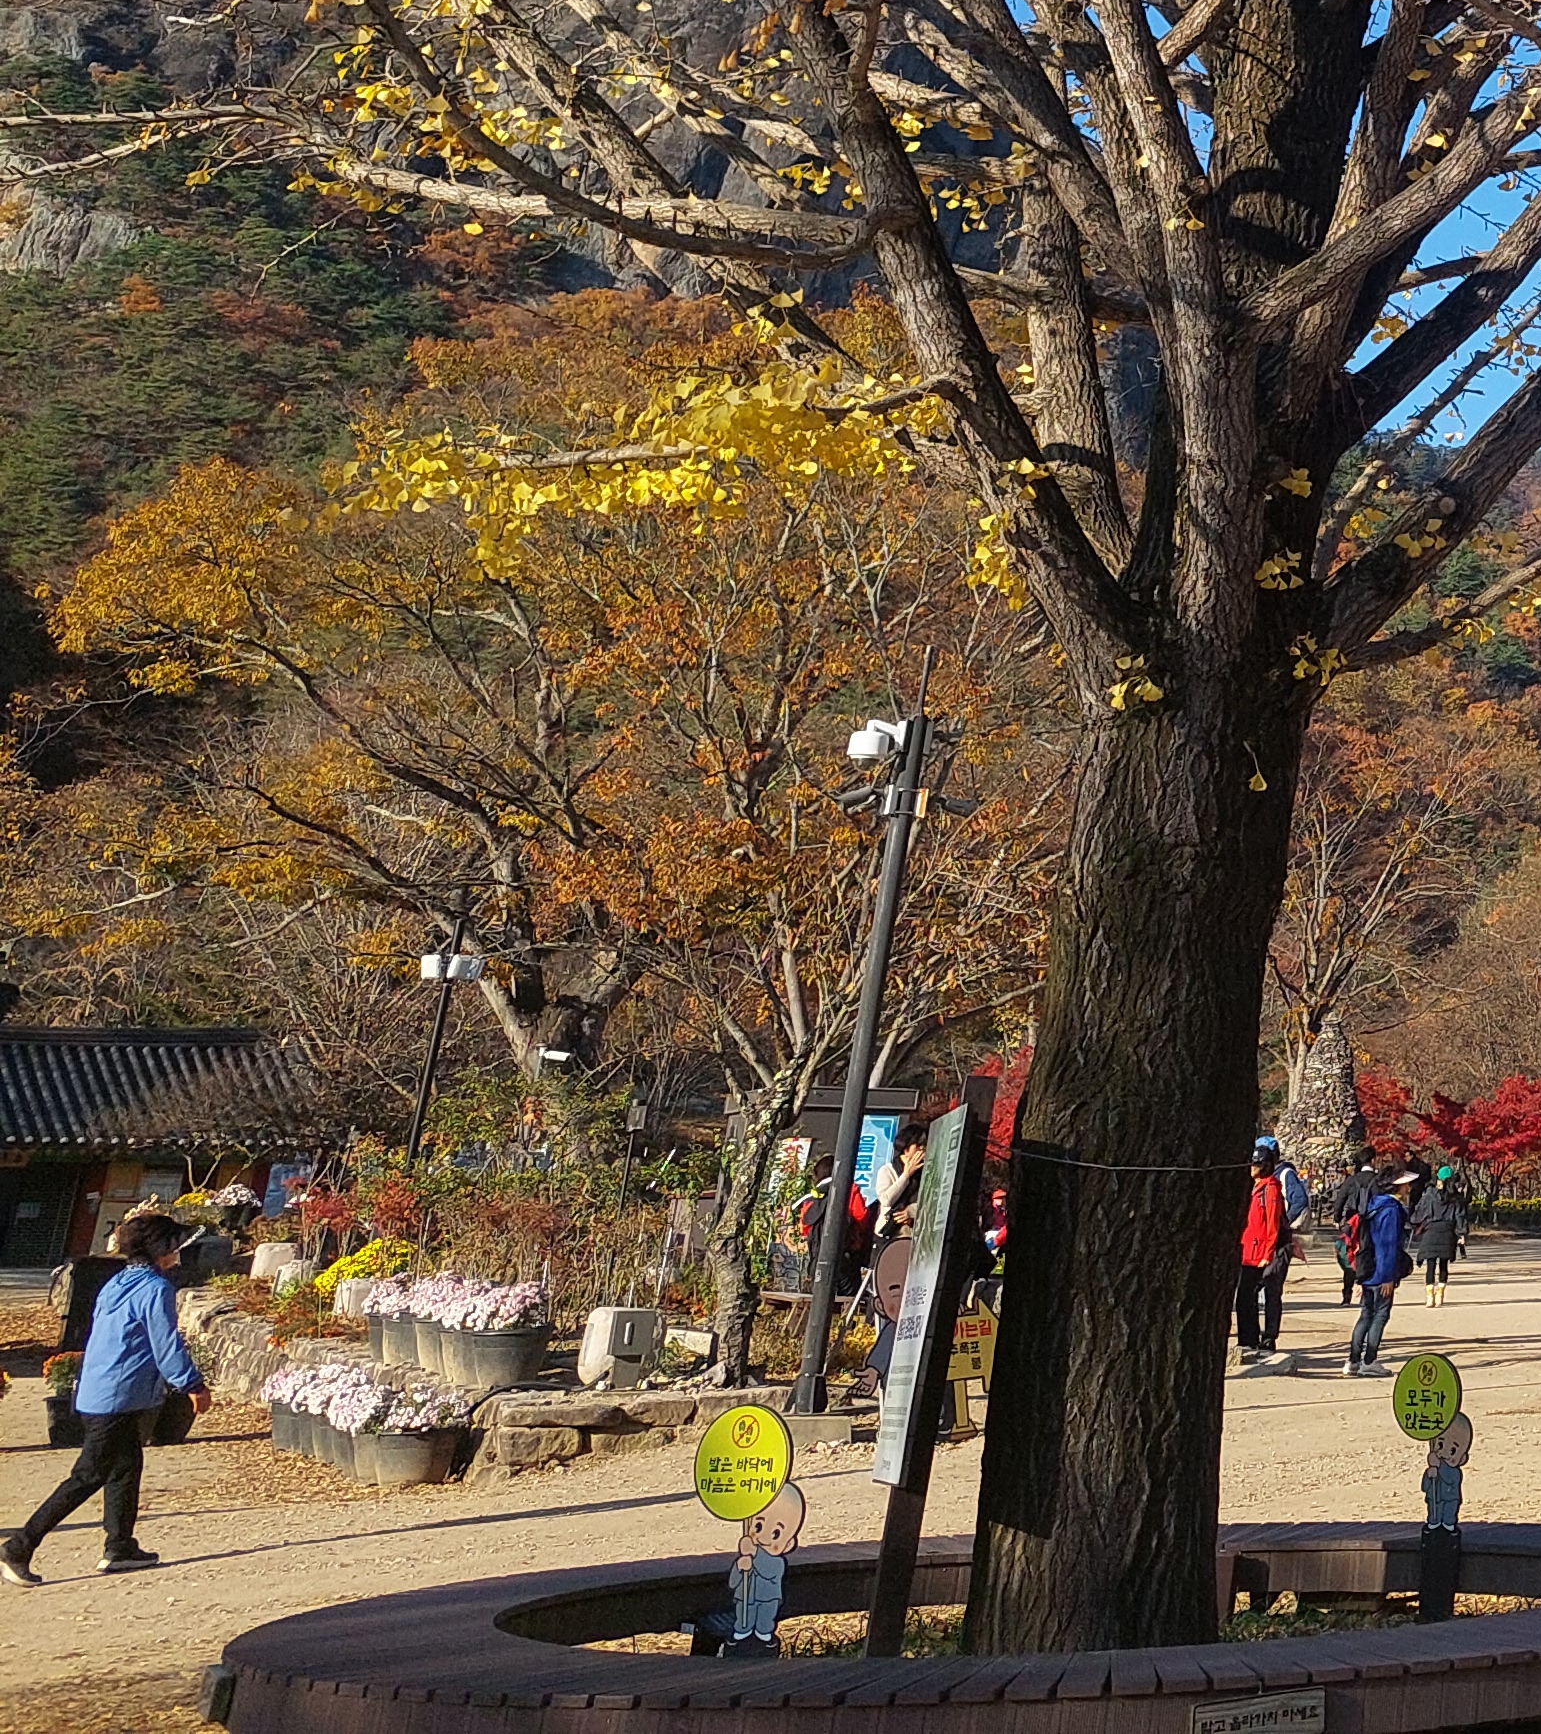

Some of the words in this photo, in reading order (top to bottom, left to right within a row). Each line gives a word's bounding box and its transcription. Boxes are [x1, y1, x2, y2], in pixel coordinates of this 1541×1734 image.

[1405, 1389, 1446, 1408] 모두가
[736, 1456, 774, 1473] 바닥에
[700, 1477, 736, 1493] 마음은
[740, 1477, 777, 1493] 여기에
[1229, 1710, 1279, 1732] 올라가지
[1282, 1705, 1319, 1722] 마세요
